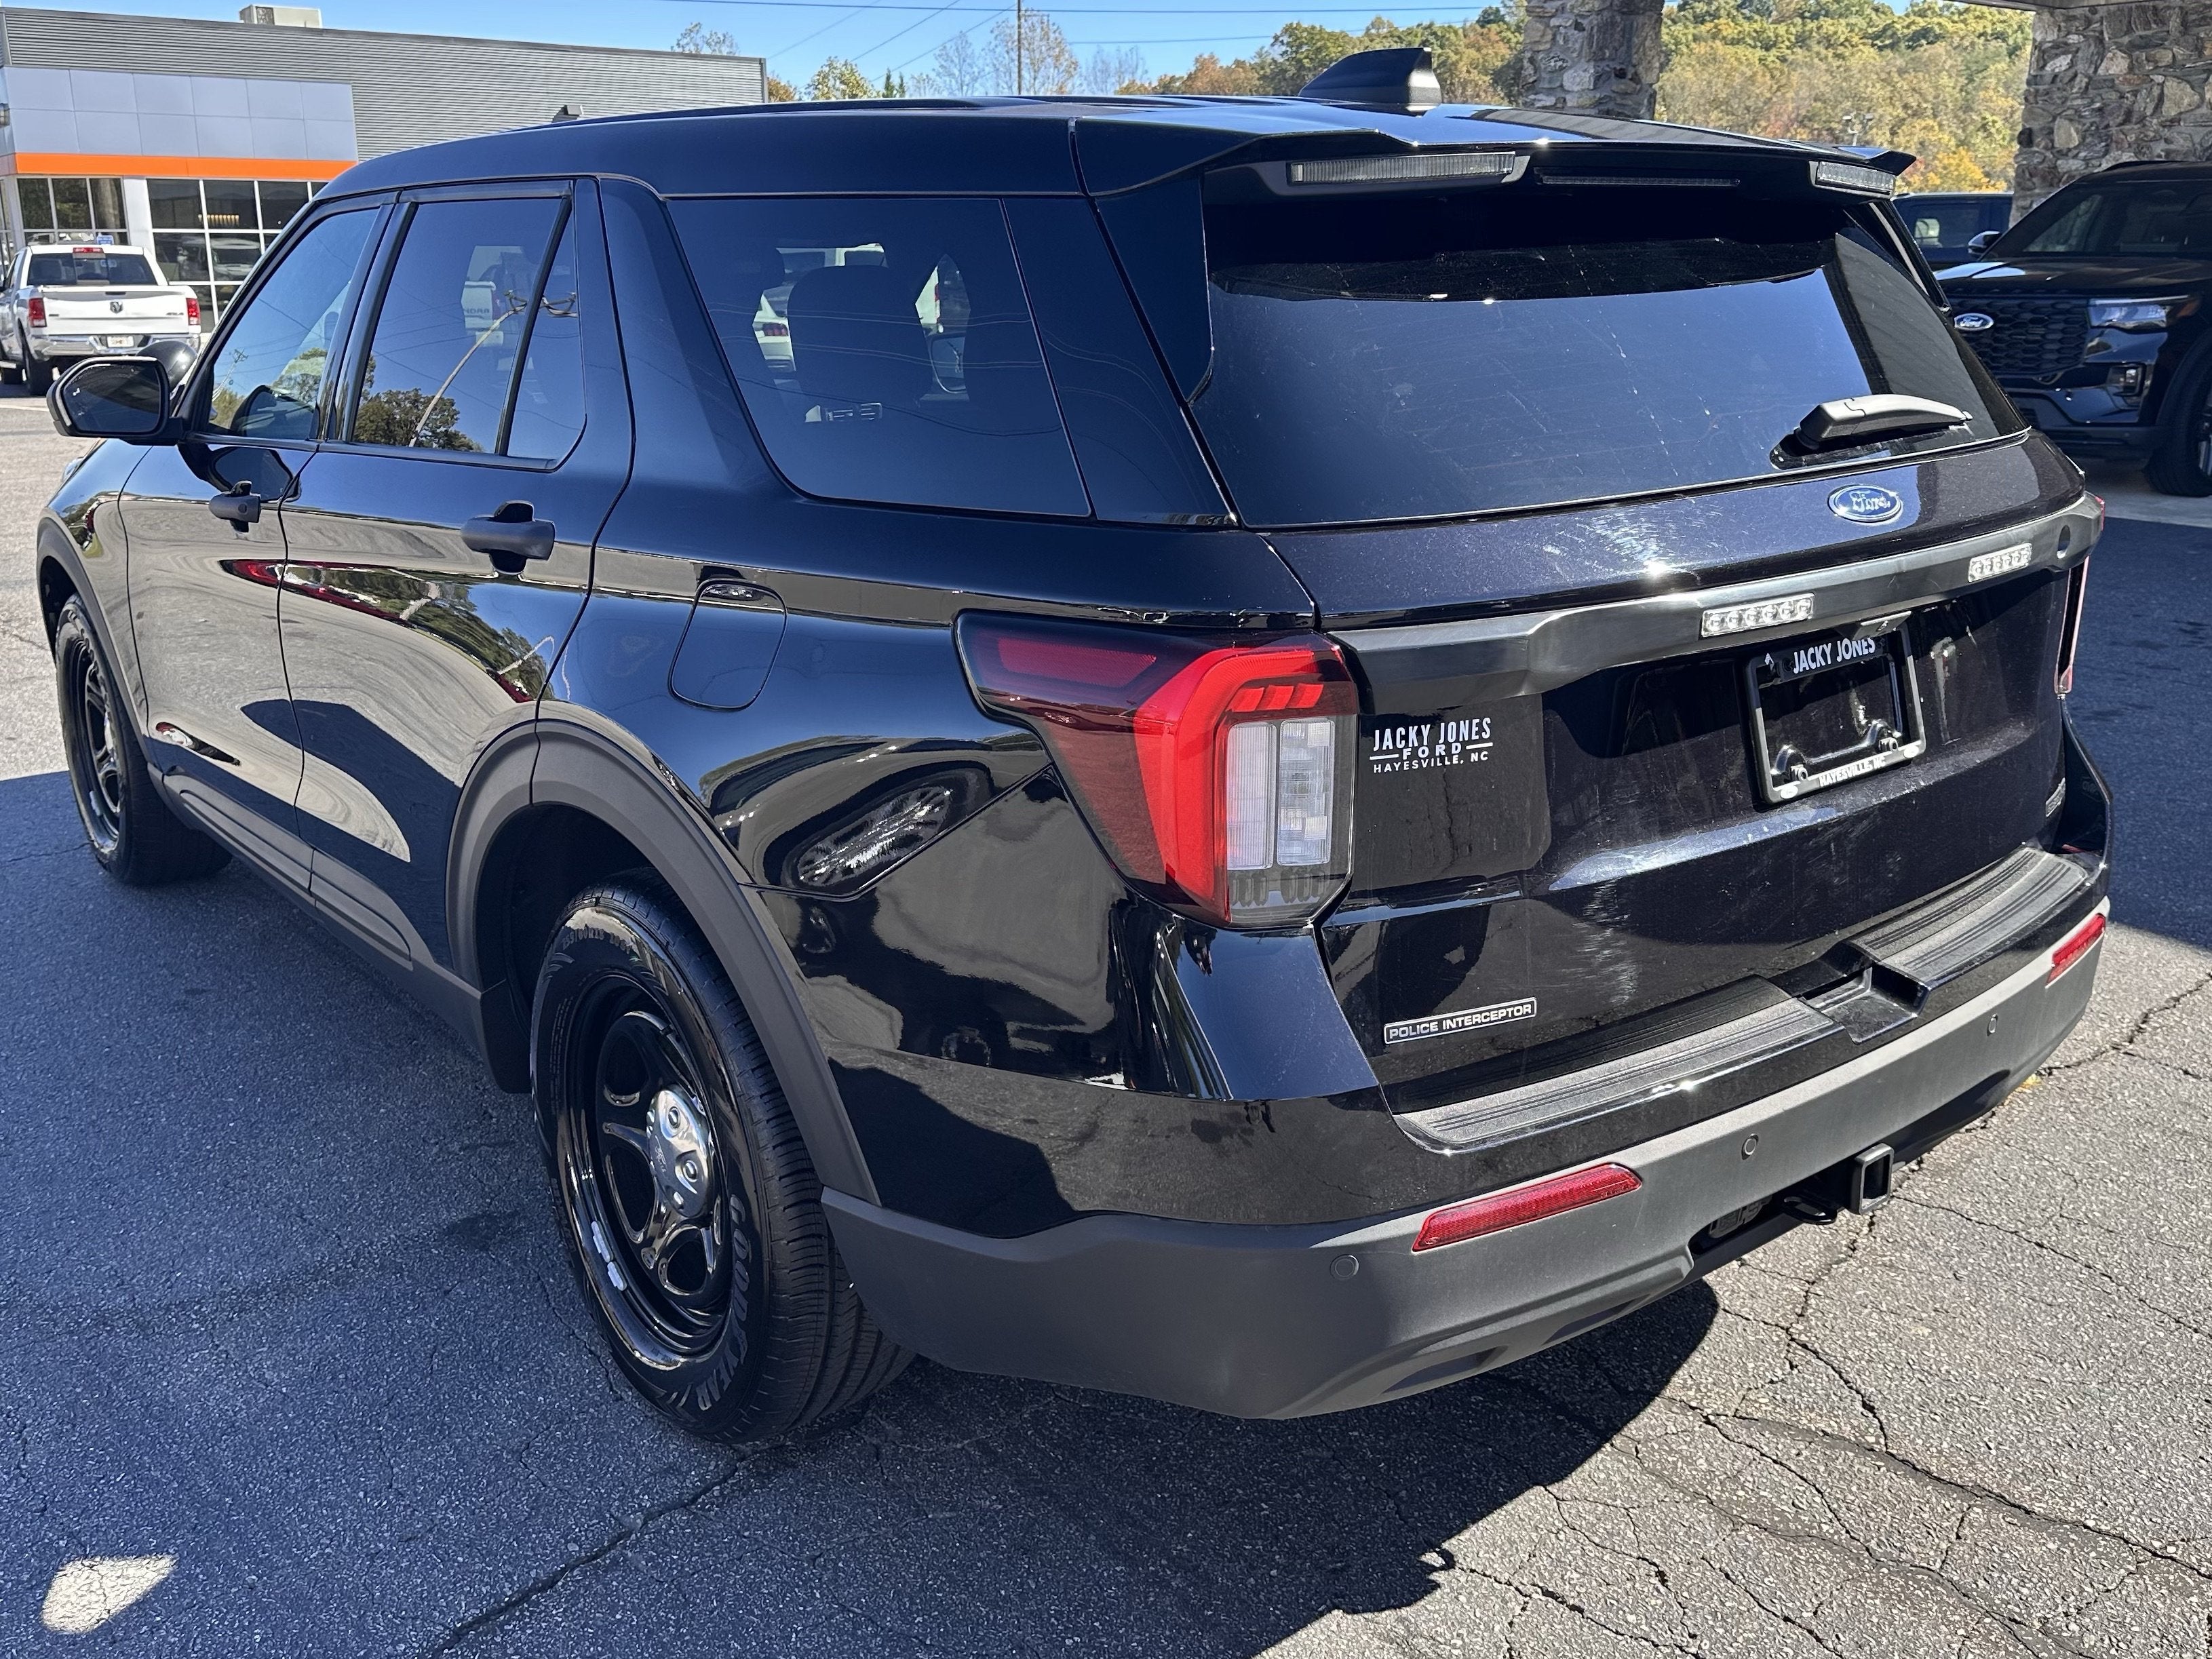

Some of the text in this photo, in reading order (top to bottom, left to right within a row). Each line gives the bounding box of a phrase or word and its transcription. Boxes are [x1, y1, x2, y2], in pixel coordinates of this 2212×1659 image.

[1849, 489, 1891, 513] Ford
[1793, 637, 1876, 674] JACKY JONES
[1373, 717, 1492, 752] JACKY JONES
[1374, 751, 1489, 773] HAYESVILLE, NC
[1403, 742, 1462, 760] FORD
[1873, 756, 1886, 769] NC
[1389, 1004, 1532, 1039] POLICE INTERCEPTOR
[695, 1194, 750, 1411] GOODYEAR
